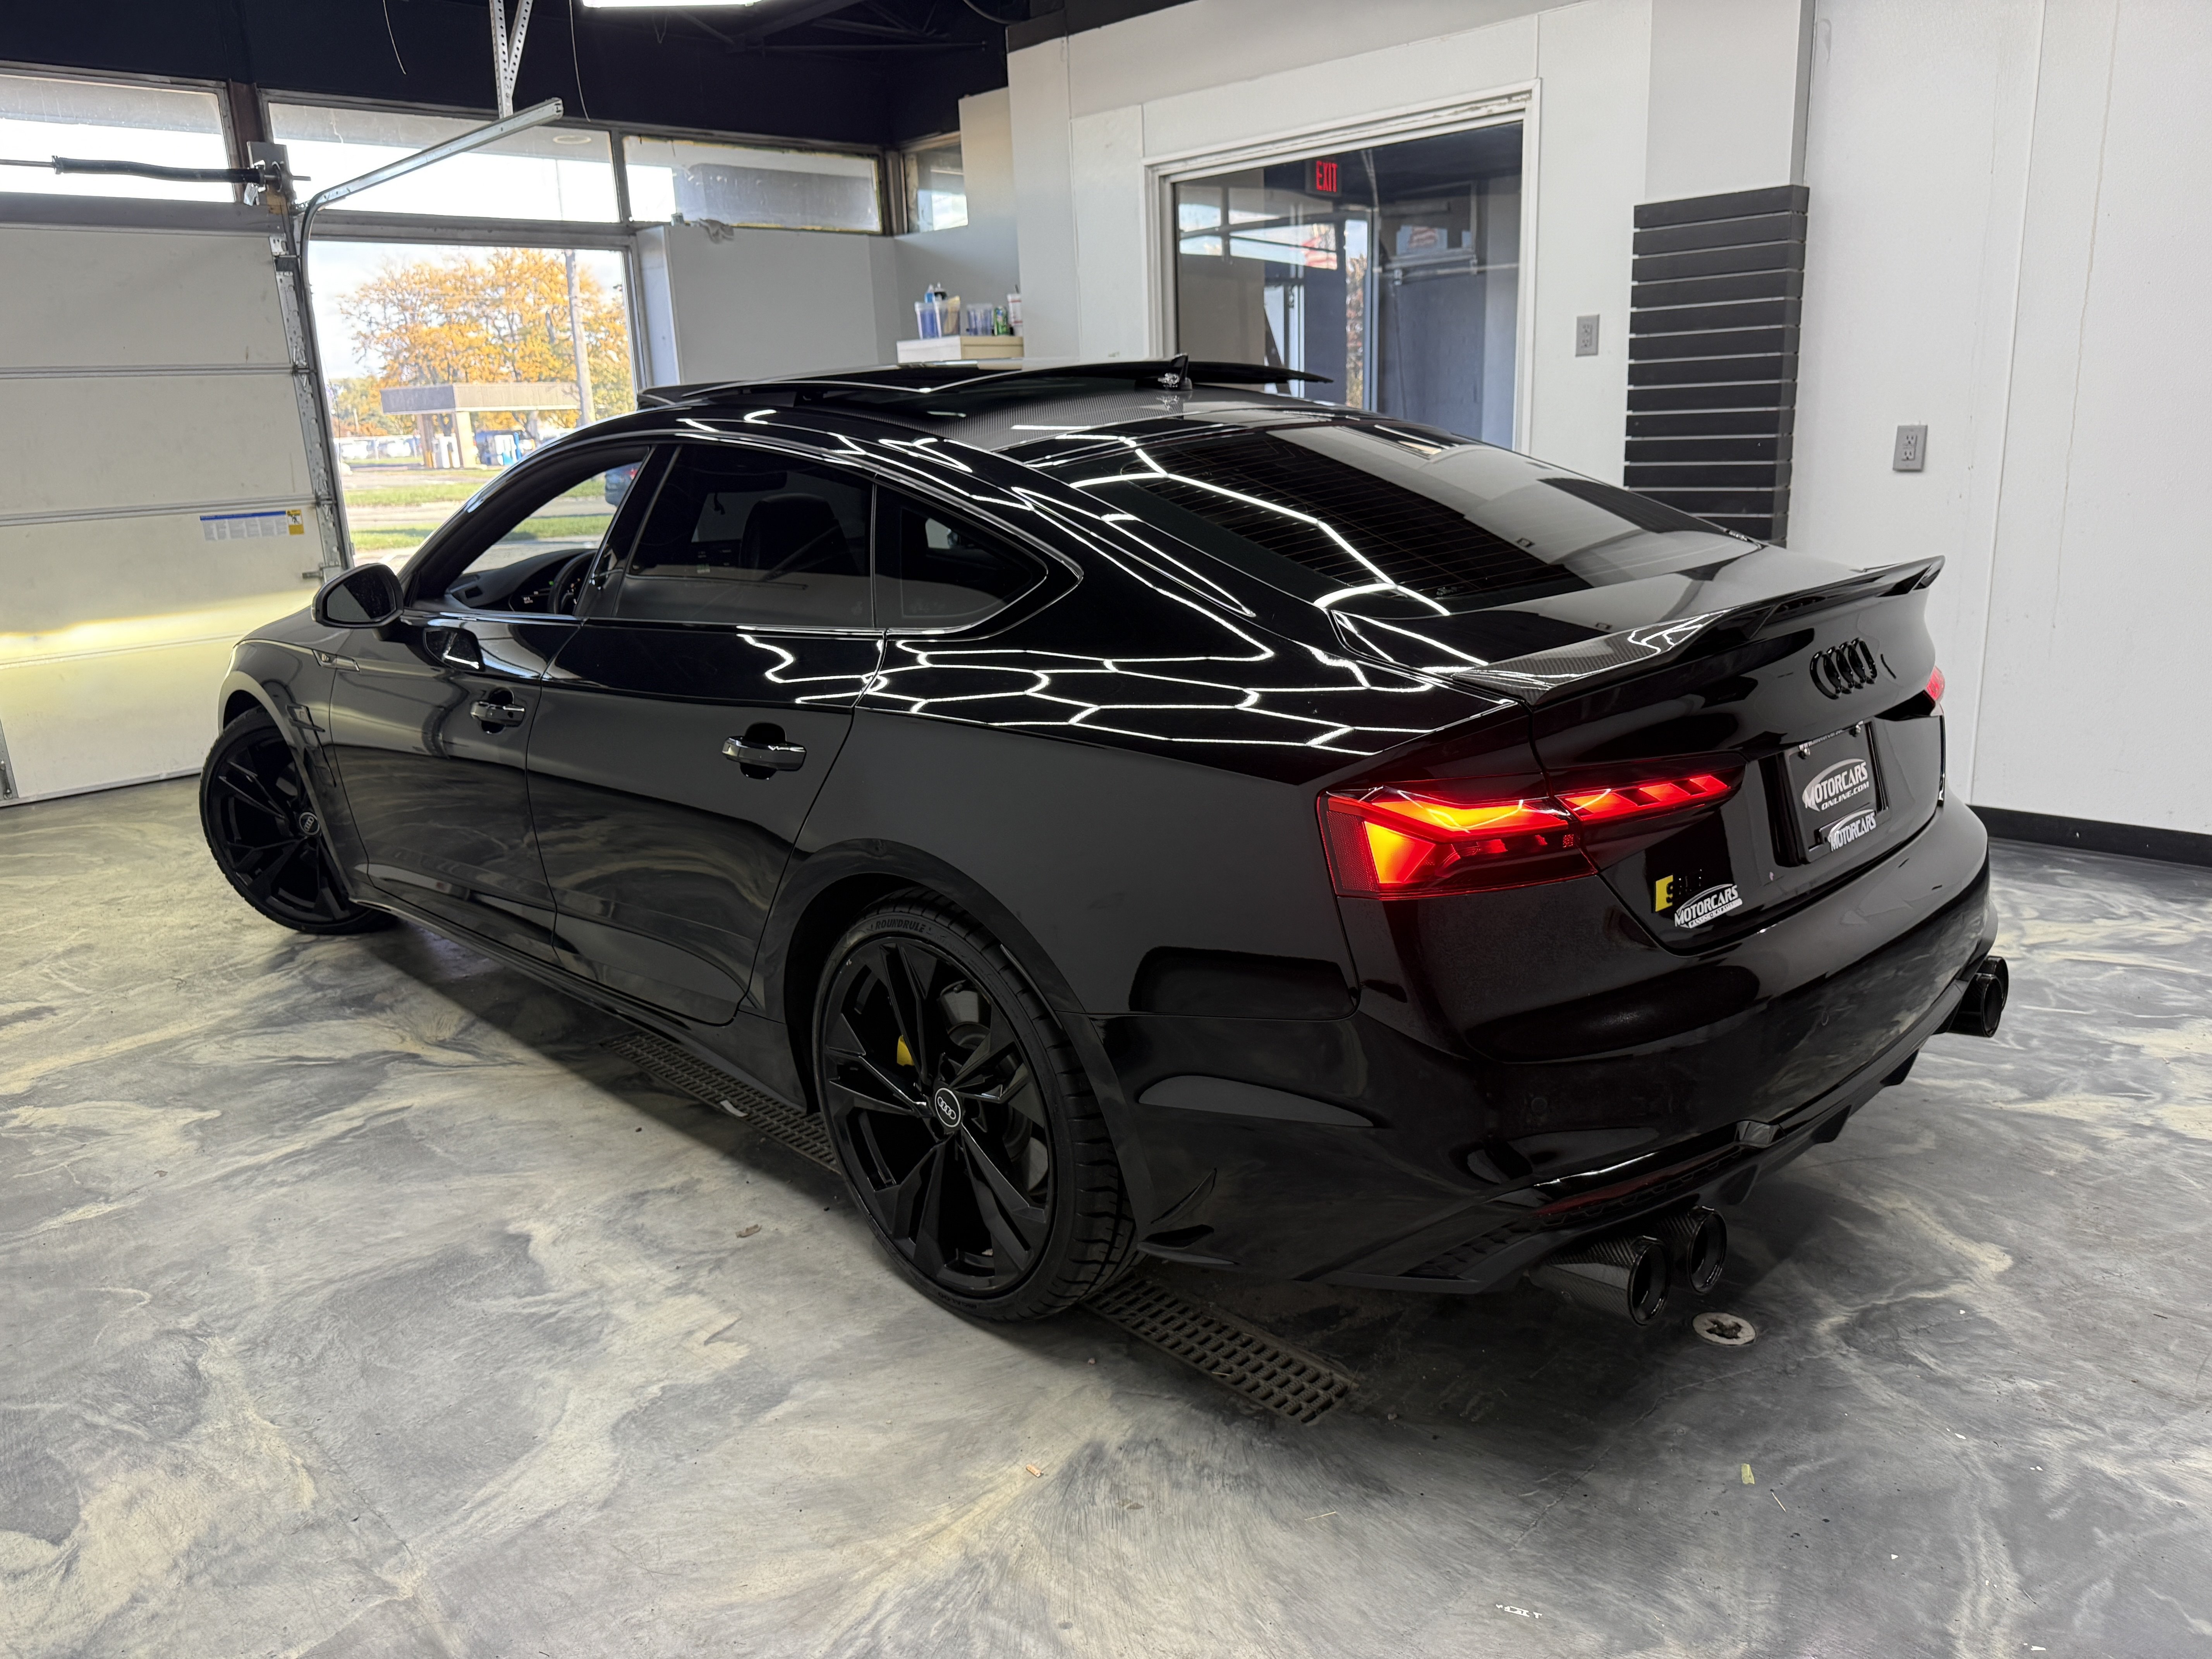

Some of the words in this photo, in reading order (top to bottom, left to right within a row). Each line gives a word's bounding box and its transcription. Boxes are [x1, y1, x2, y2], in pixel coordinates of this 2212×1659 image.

[1316, 161, 1338, 192] EXIT
[1804, 761, 1868, 809] MOTORCARS
[1821, 781, 1870, 811] ONLINE.COM
[1829, 812, 1877, 852] MOTORCARS
[1674, 884, 1739, 927] MOTORCARS
[875, 918, 926, 933] ROUNDRULE
